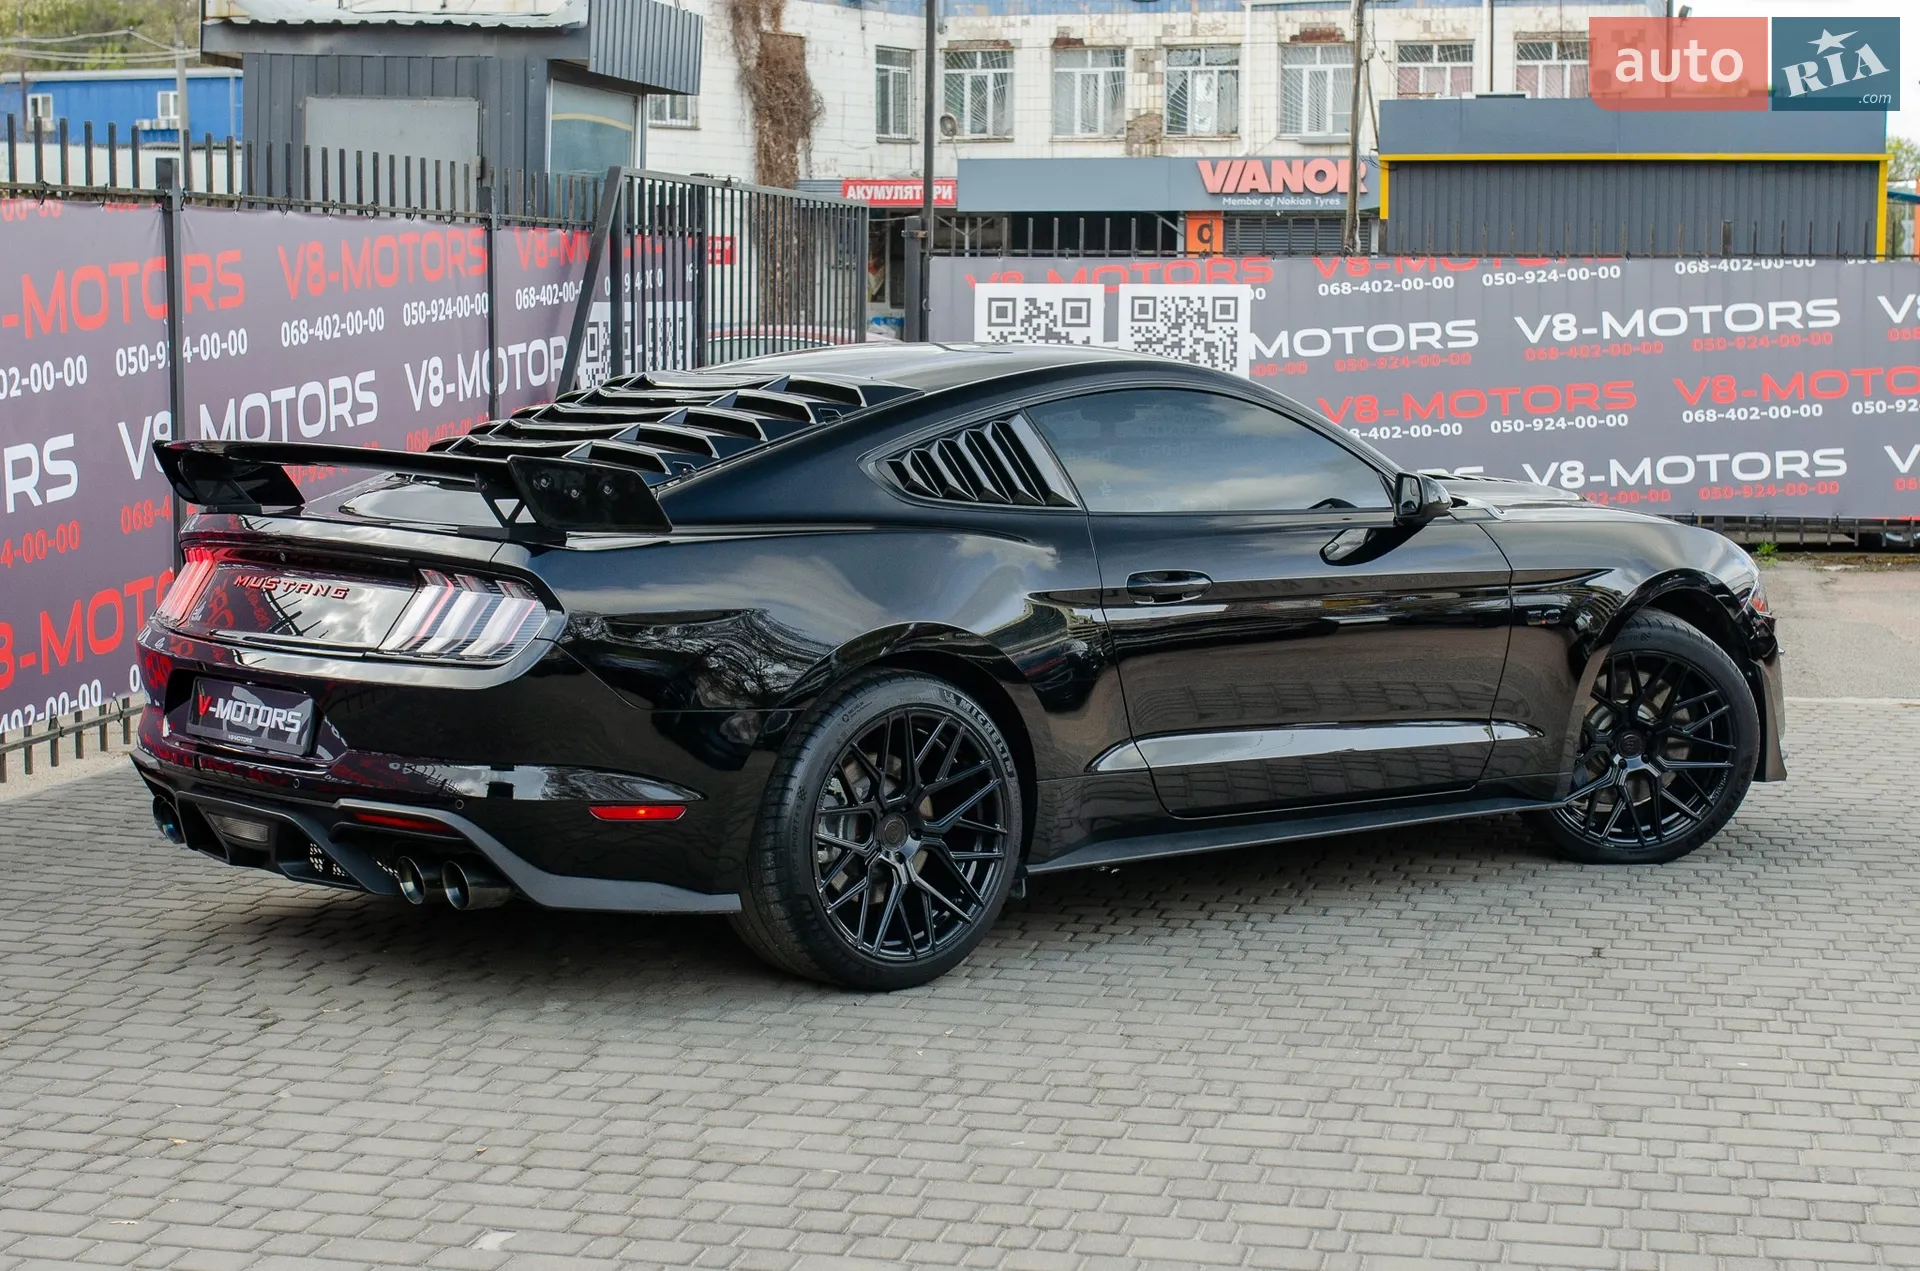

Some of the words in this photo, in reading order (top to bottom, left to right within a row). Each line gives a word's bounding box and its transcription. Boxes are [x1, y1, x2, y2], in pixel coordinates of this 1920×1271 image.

[846, 185, 953, 200] АКУМУЛЯТРИ
[1197, 158, 1368, 194] VIANOR
[1222, 197, 1261, 206] Member
[1264, 197, 1275, 207] of
[1277, 197, 1312, 206] Nokian
[1314, 197, 1341, 207] Tyres
[278, 228, 488, 300] V8-MOTORS
[965, 256, 1274, 293] VMOTORS
[1318, 275, 1455, 296] 068-402-00-00
[1482, 265, 1621, 288] 050-924-00-00
[281, 306, 386, 348] 068-402-00-00
[402, 291, 489, 327] 050-924-00-00
[1514, 298, 1841, 344] V8-MOTORS
[116, 327, 249, 378] 050-94-00-00
[1691, 331, 1834, 353] 050-924-00-00
[1335, 352, 1472, 373] 050-924-00-00
[1317, 380, 1637, 424] V8-MOTORS
[1682, 404, 1823, 423] 068-402-00-00
[1851, 399, 1920, 415] 050-92
[118, 369, 379, 481] V8MOTORS
[1490, 413, 1628, 434] 050-924-00-00
[1521, 447, 1847, 489] V8-MOTORS
[233, 575, 350, 600] MUSTANG
[198, 694, 303, 733] V-MOTORS
[959, 698, 1015, 774] MICHELIN
